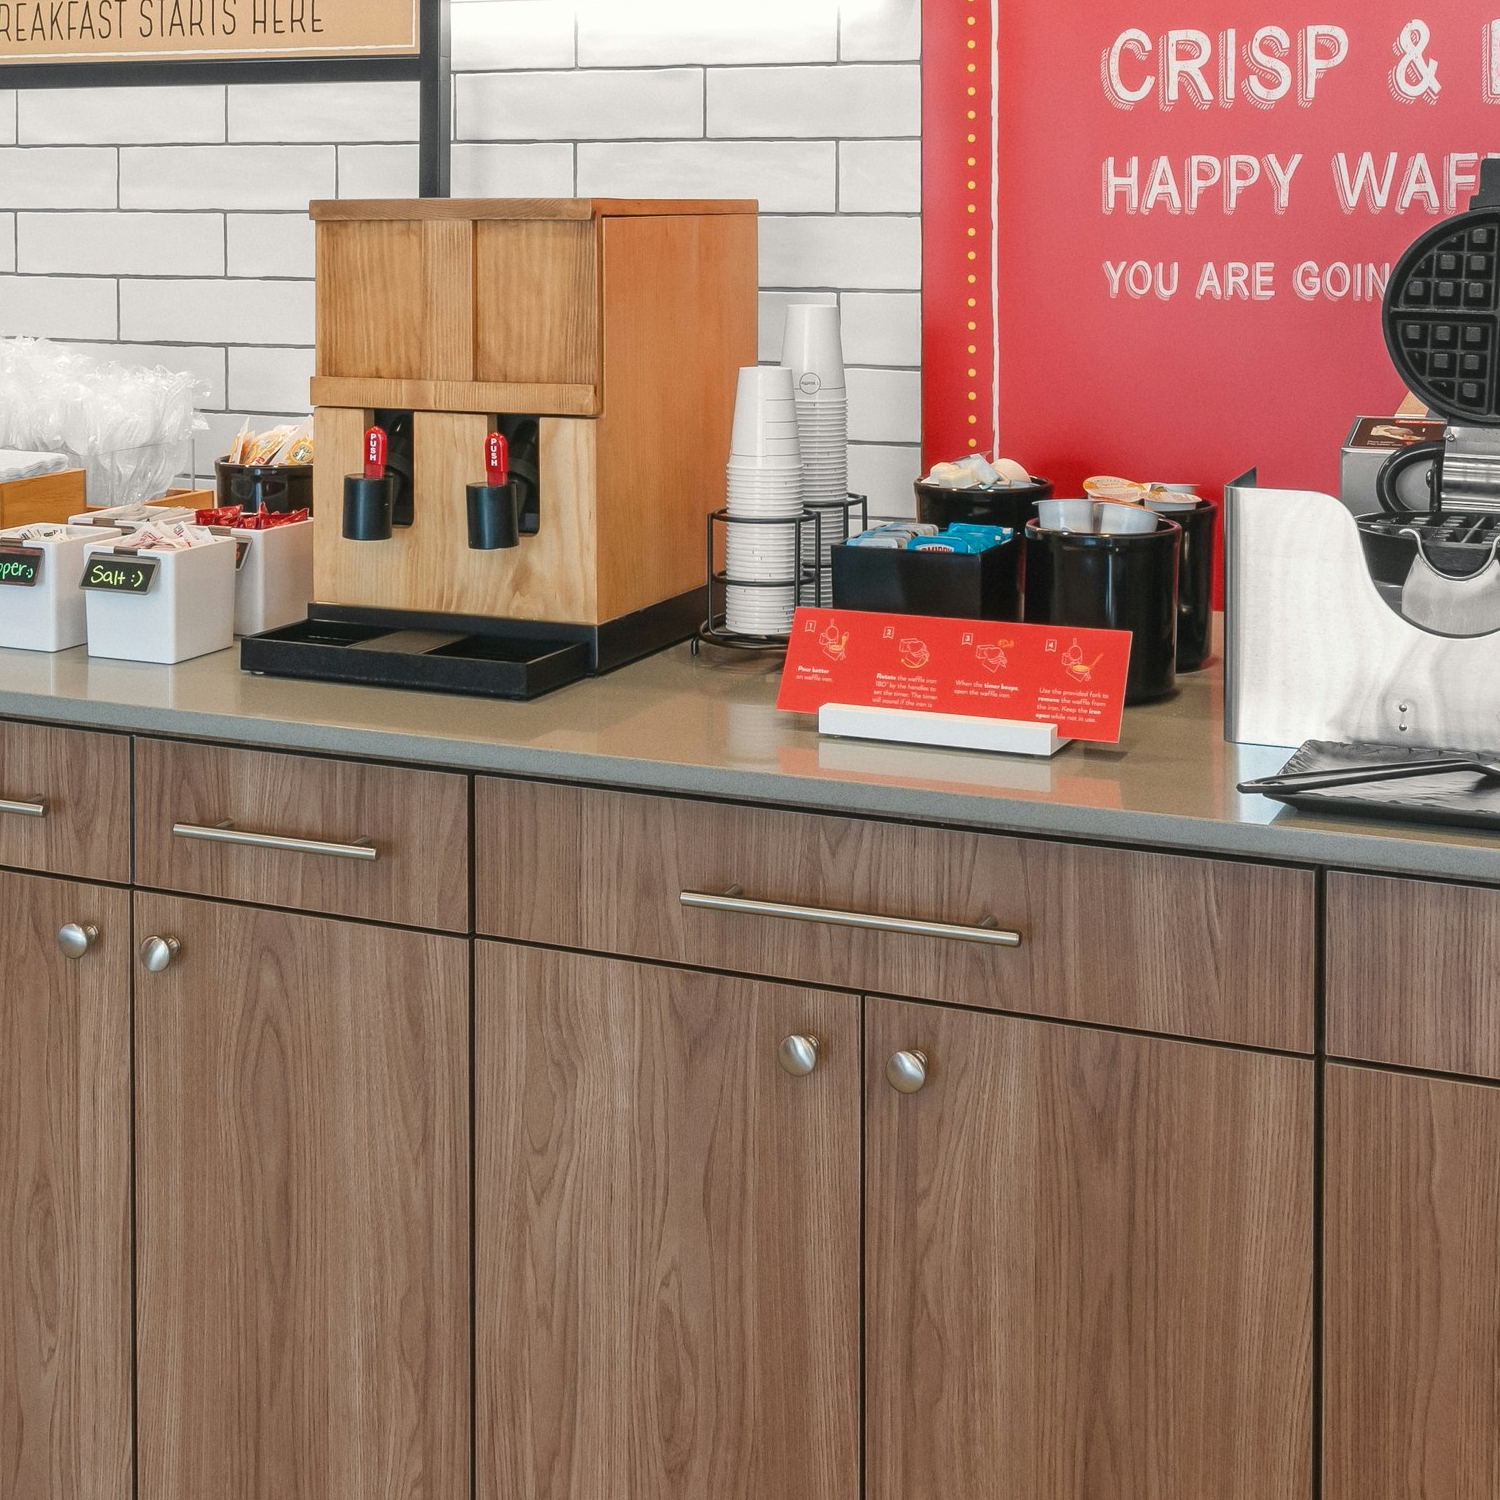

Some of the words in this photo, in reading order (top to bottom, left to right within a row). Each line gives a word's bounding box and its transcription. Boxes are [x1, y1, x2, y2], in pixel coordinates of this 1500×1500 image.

[1102, 24, 1349, 110] CRISP
[1389, 18, 1443, 106] &
[1103, 151, 1303, 217] HAPPY
[1103, 260, 1179, 301] YOU
[1196, 261, 1275, 300] ARE
[369, 433, 377, 461] PUSH
[490, 437, 498, 467] PUSH
[90, 564, 126, 586] Salt
